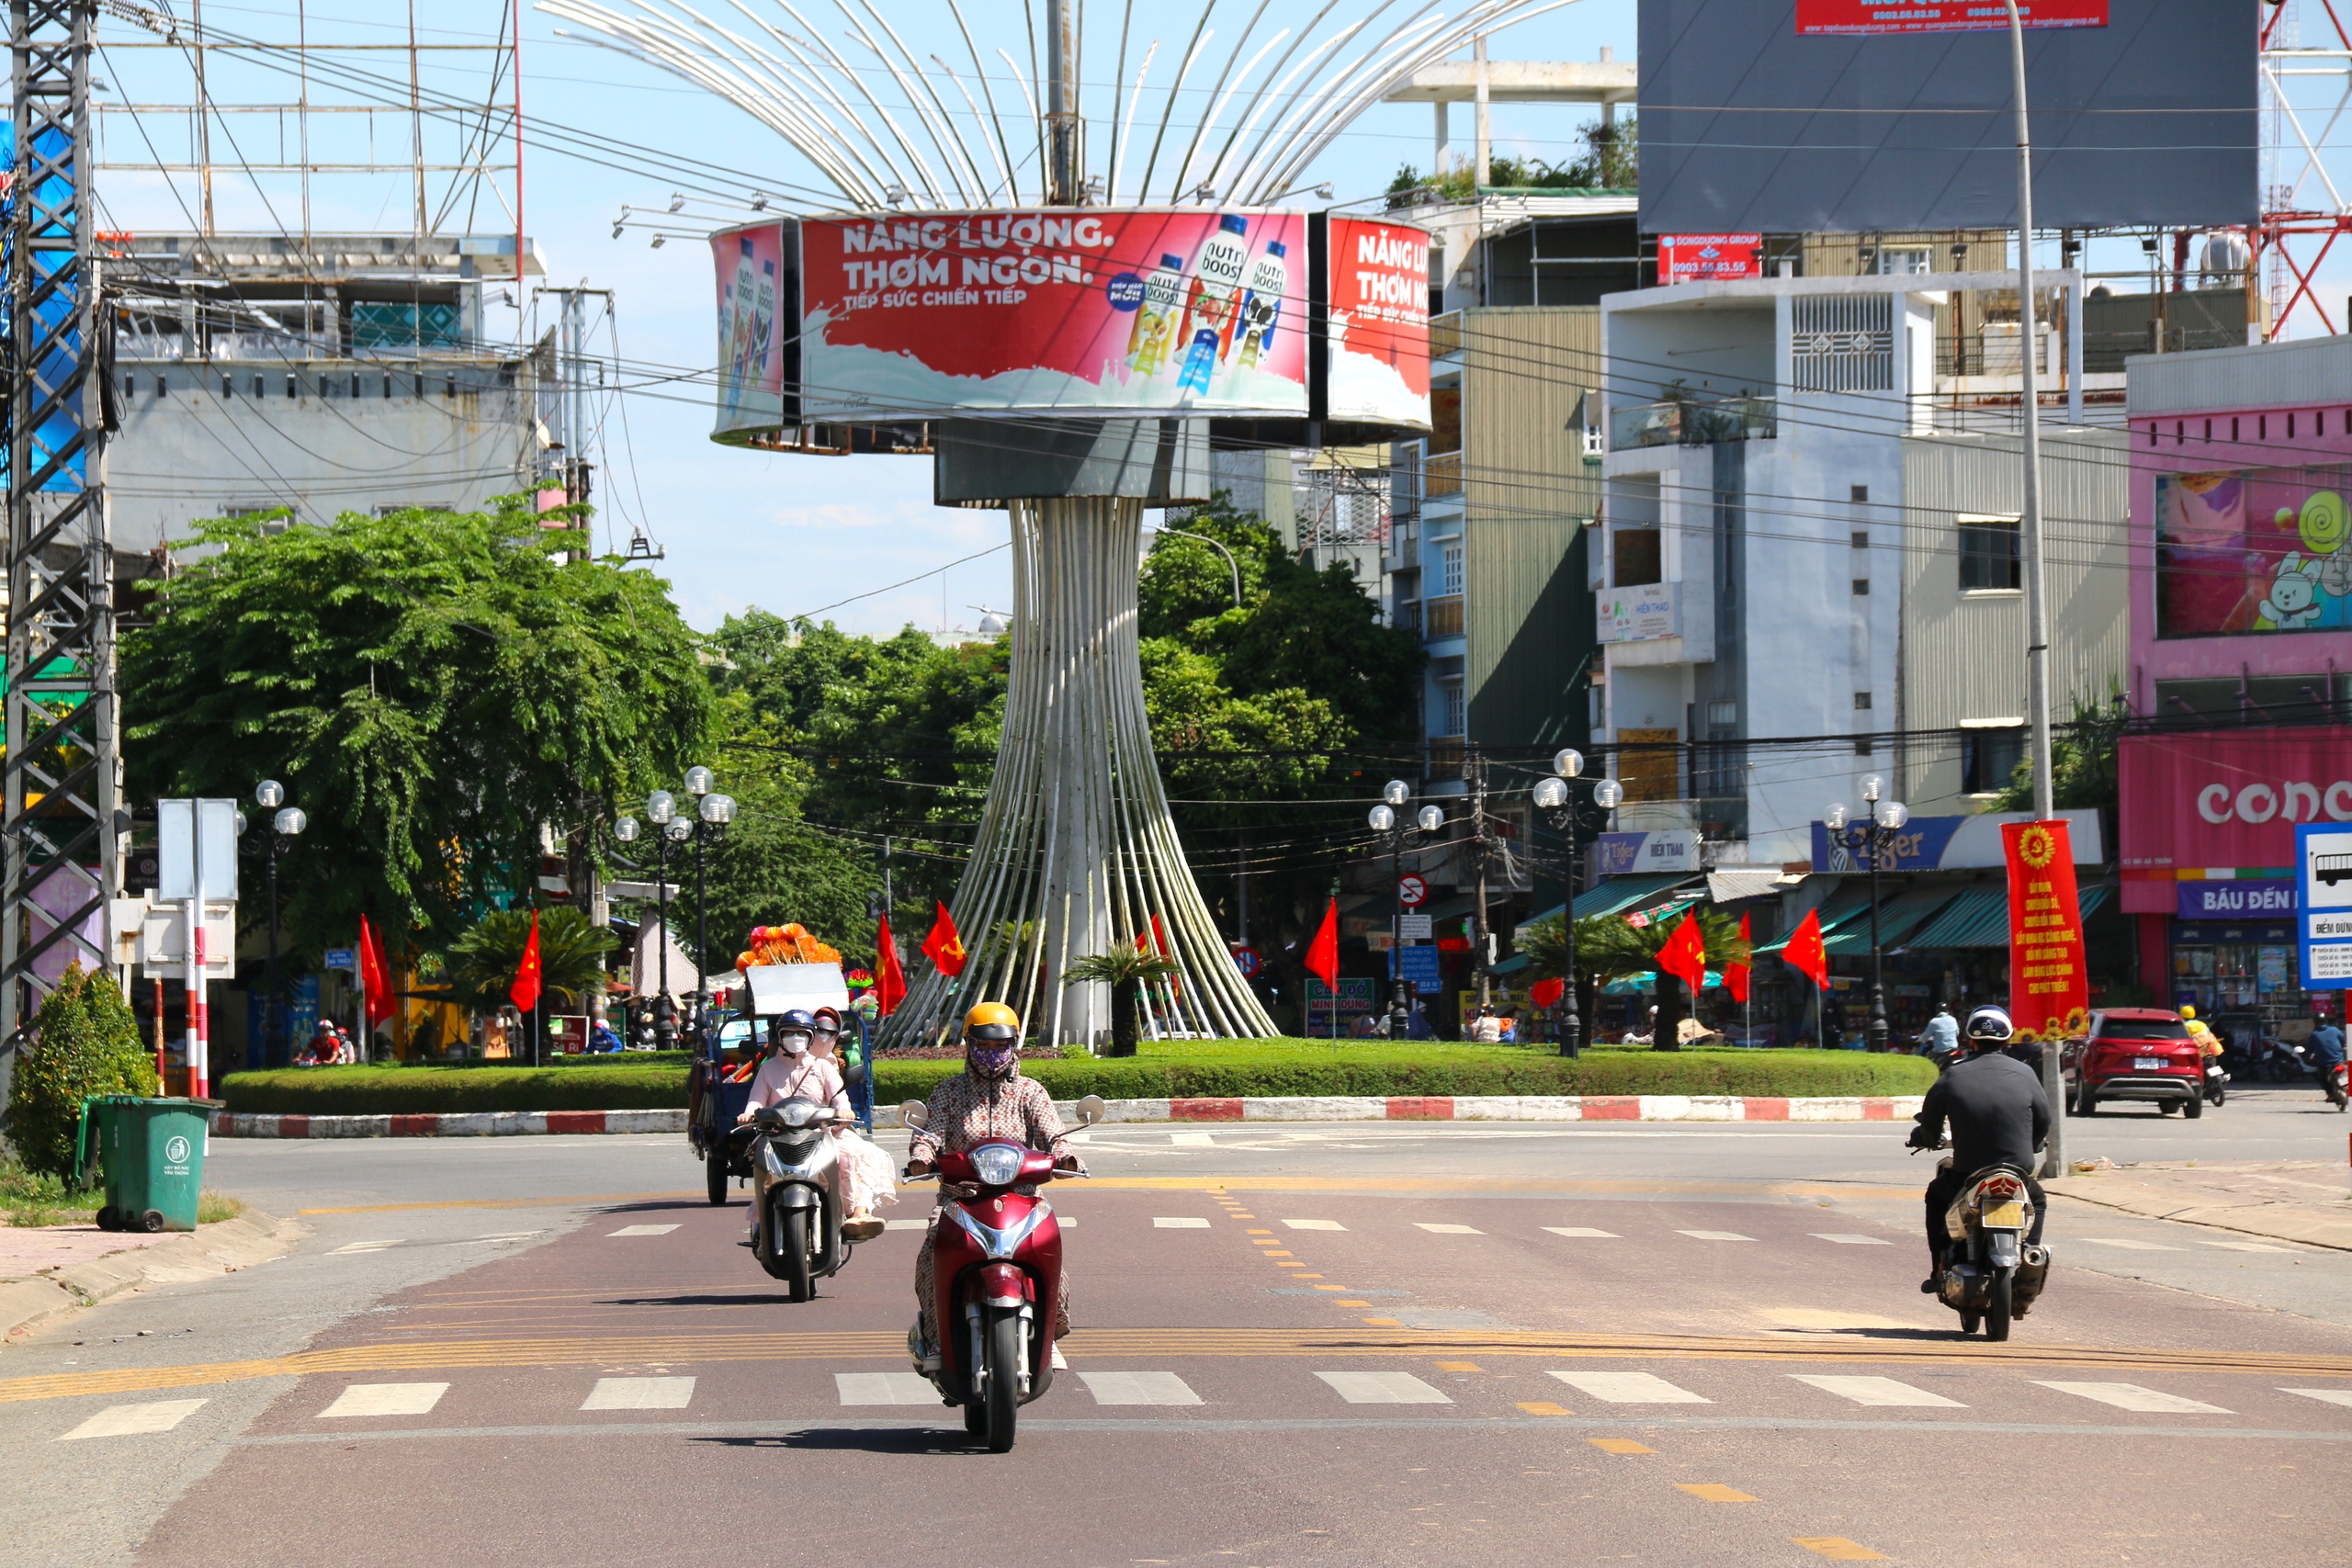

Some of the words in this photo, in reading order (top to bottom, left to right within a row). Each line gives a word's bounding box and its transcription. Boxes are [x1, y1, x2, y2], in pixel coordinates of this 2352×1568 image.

[1357, 229, 1413, 269] NĂNG
[1729, 235, 1758, 245] GROUP
[842, 253, 950, 290] THƠM
[962, 254, 1094, 287] NGON.
[1674, 261, 1747, 273] 0903.55.83.55
[842, 288, 879, 310] TIẾP
[882, 291, 918, 308] SỨC
[922, 286, 979, 307] CHIẾN
[984, 284, 1028, 305] TIẾP
[1356, 270, 1412, 306] THƠM
[1611, 840, 1635, 865] Tiger
[1854, 827, 1924, 871] Tger
[2248, 886, 2290, 909] ĐẾN
[2316, 919, 2334, 934] ĐIỂM
[1311, 998, 1339, 1010] MINH
